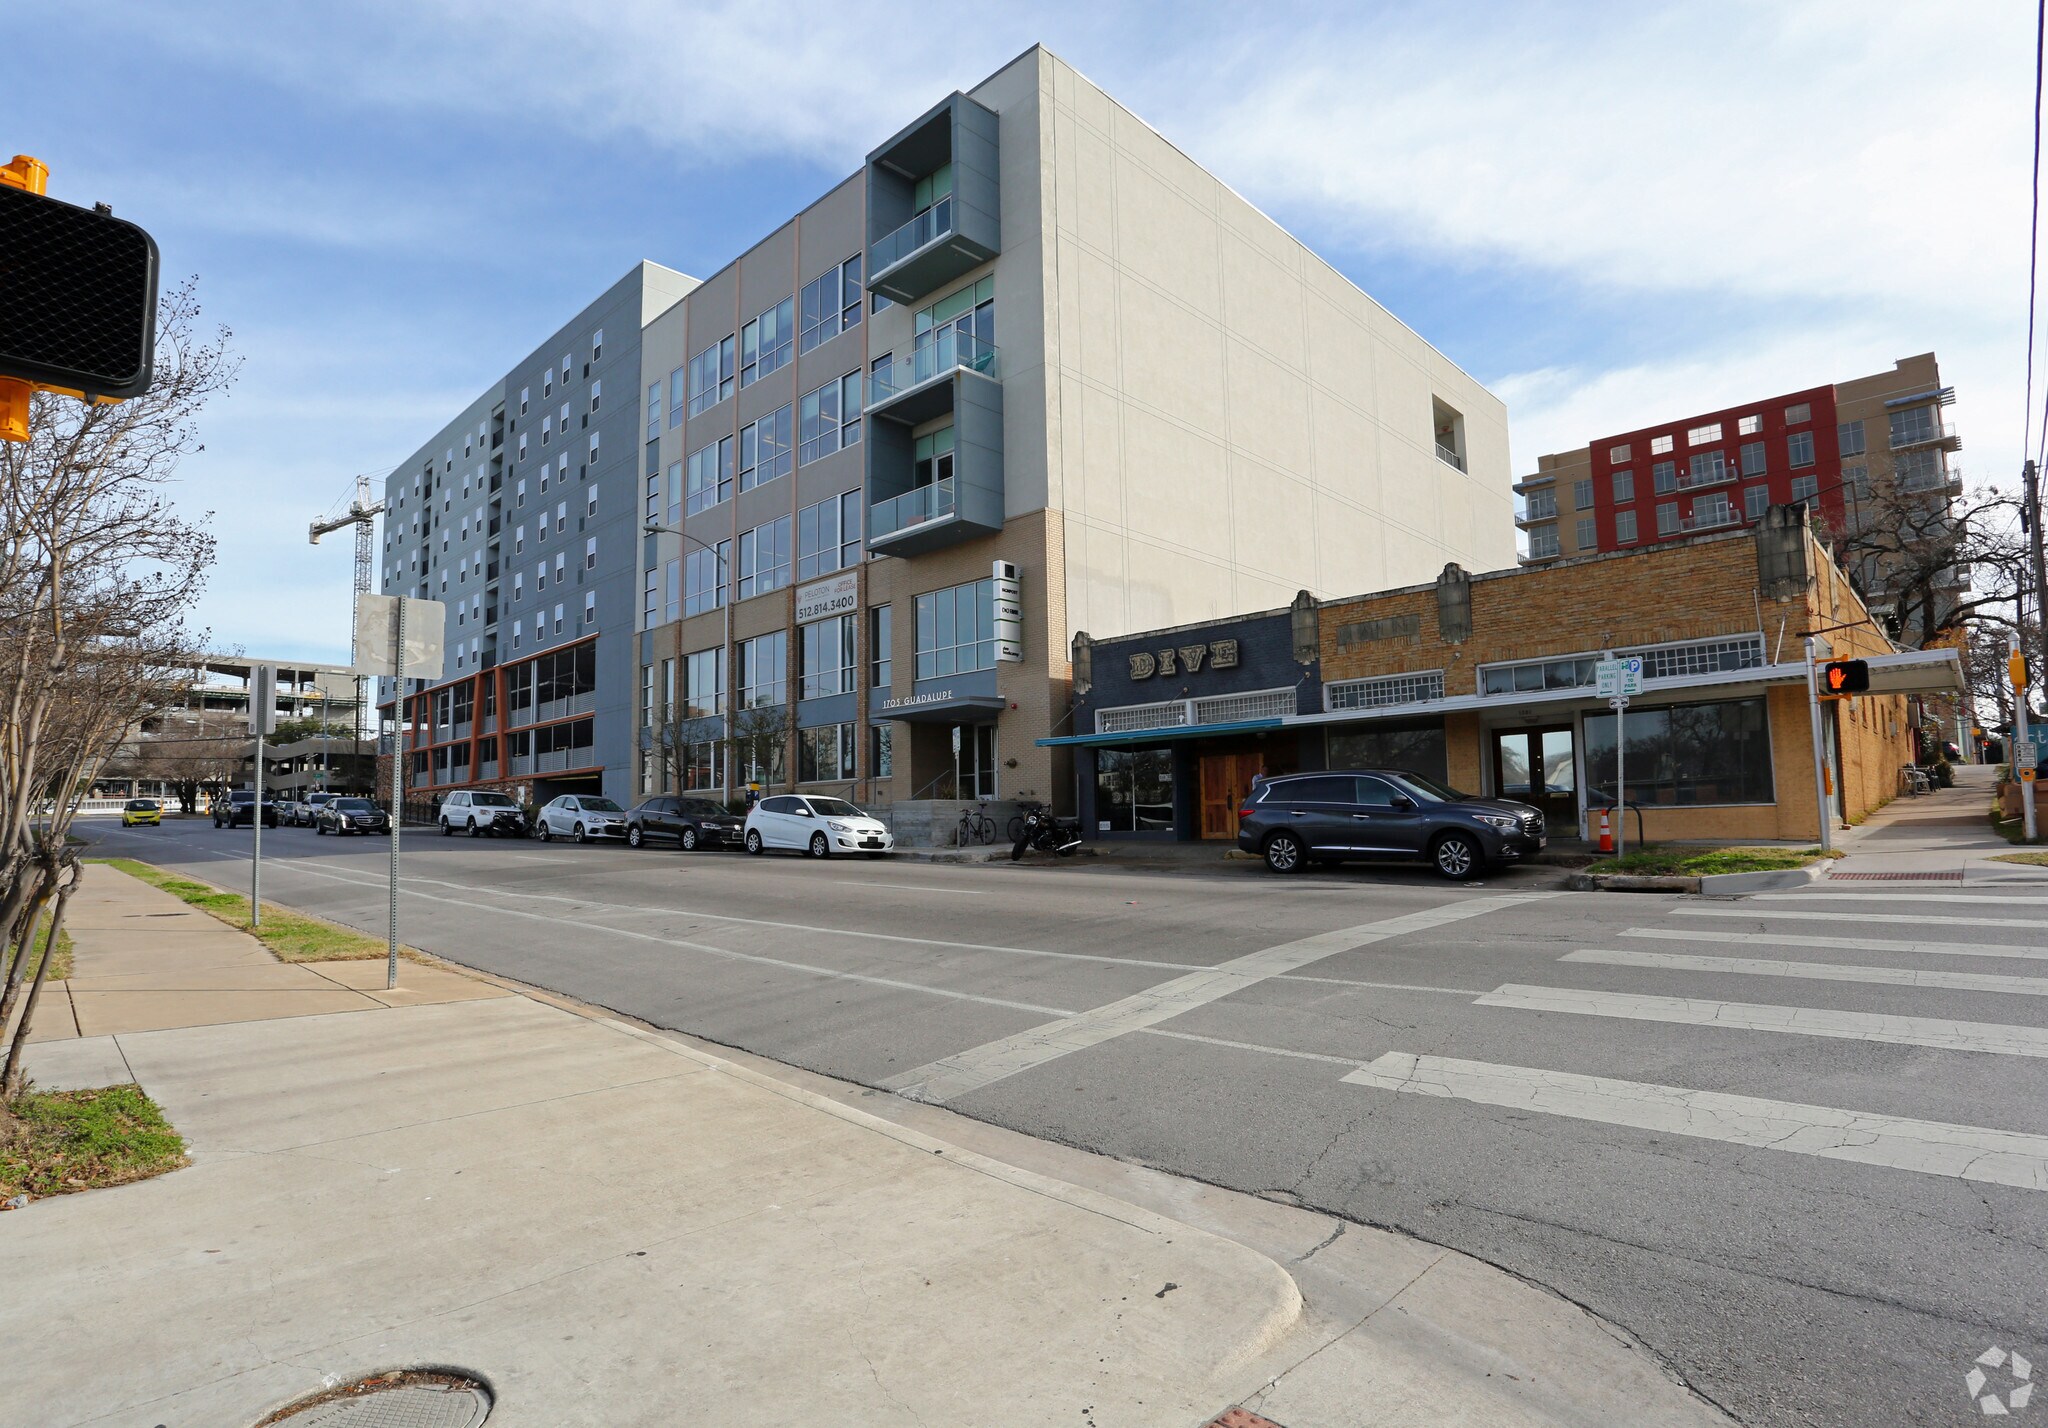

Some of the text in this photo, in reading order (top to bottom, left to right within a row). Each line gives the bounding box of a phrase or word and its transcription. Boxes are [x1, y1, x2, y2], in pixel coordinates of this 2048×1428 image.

[805, 586, 829, 598] PELOTON
[799, 595, 854, 619] 512.814.3400
[1129, 639, 1238, 679] DIVE
[883, 690, 952, 709] 1705 GUADALUPE
